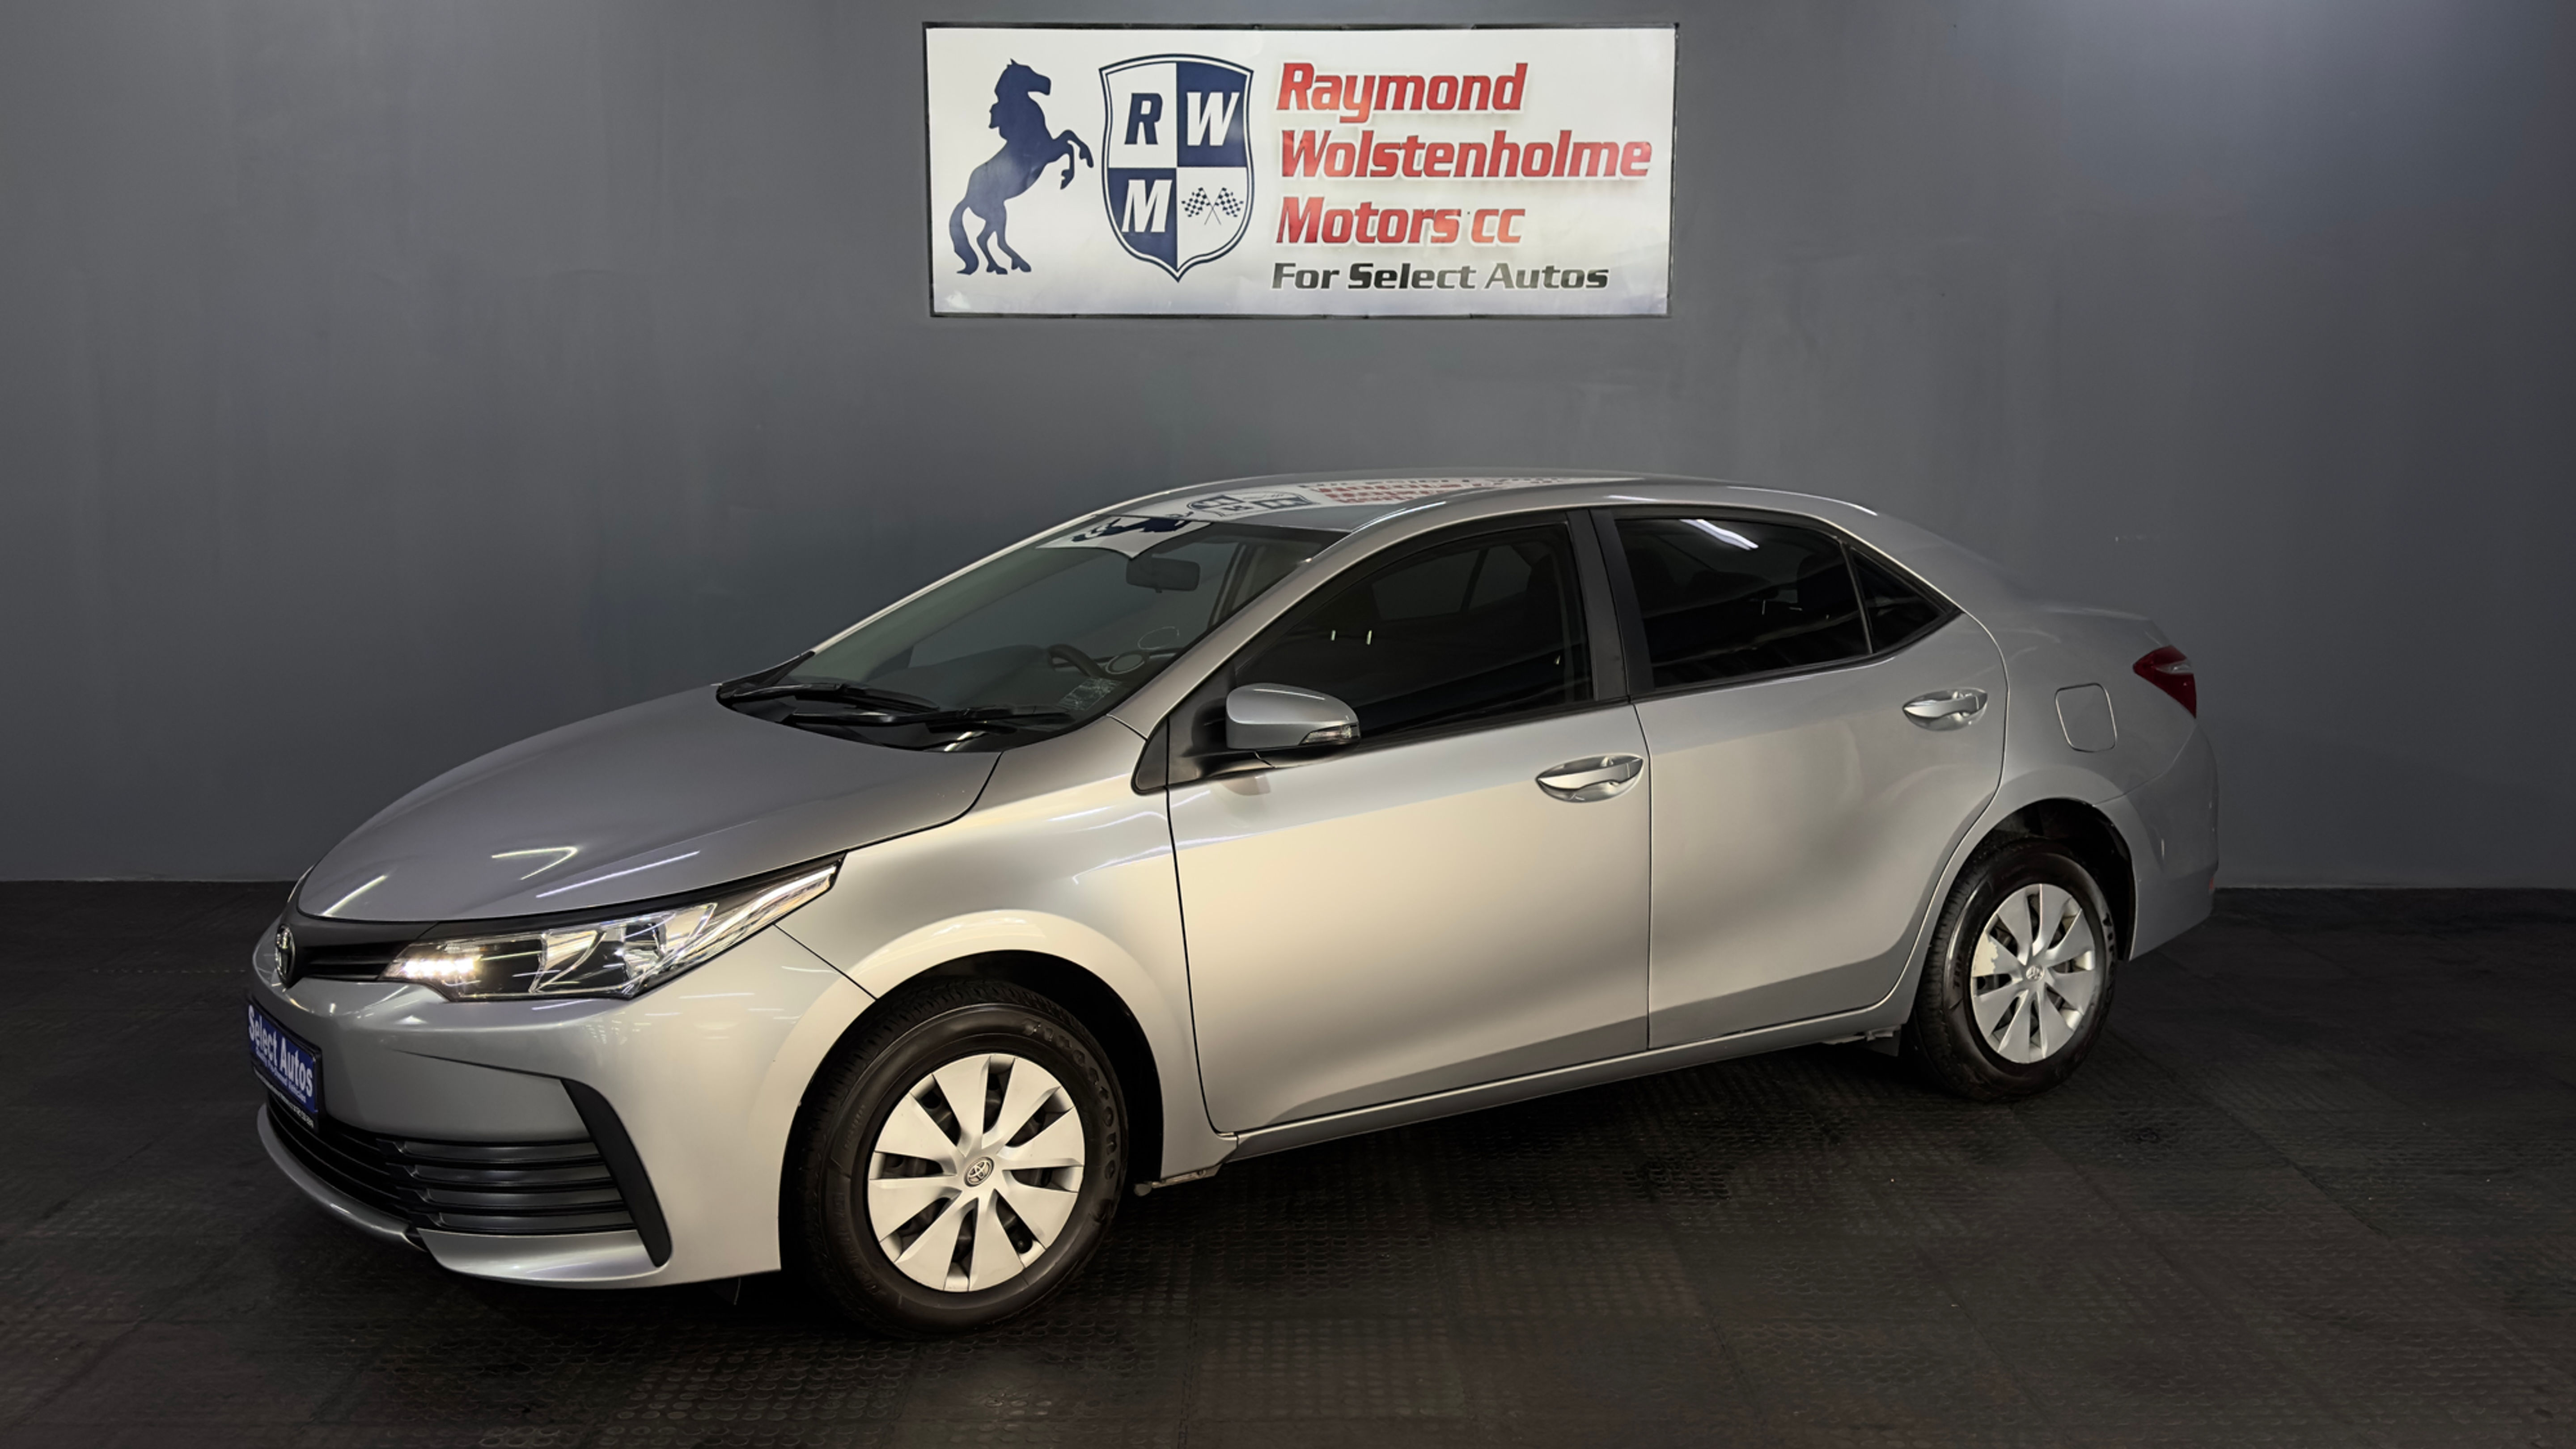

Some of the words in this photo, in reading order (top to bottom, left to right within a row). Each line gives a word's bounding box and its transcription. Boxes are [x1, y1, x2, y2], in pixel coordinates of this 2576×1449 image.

[1124, 92, 1164, 145] R
[1186, 92, 1240, 146] W
[1278, 62, 1528, 123] Raymond
[1282, 130, 1652, 178] Wolstenholme
[1121, 179, 1173, 233] M
[1276, 197, 1462, 244] Motors
[1471, 209, 1525, 243] cc
[1272, 262, 1341, 289] For
[1347, 262, 1477, 290] Select
[1484, 263, 1610, 289] Autos
[248, 1004, 278, 1064] Select
[280, 1037, 313, 1097] Autos
